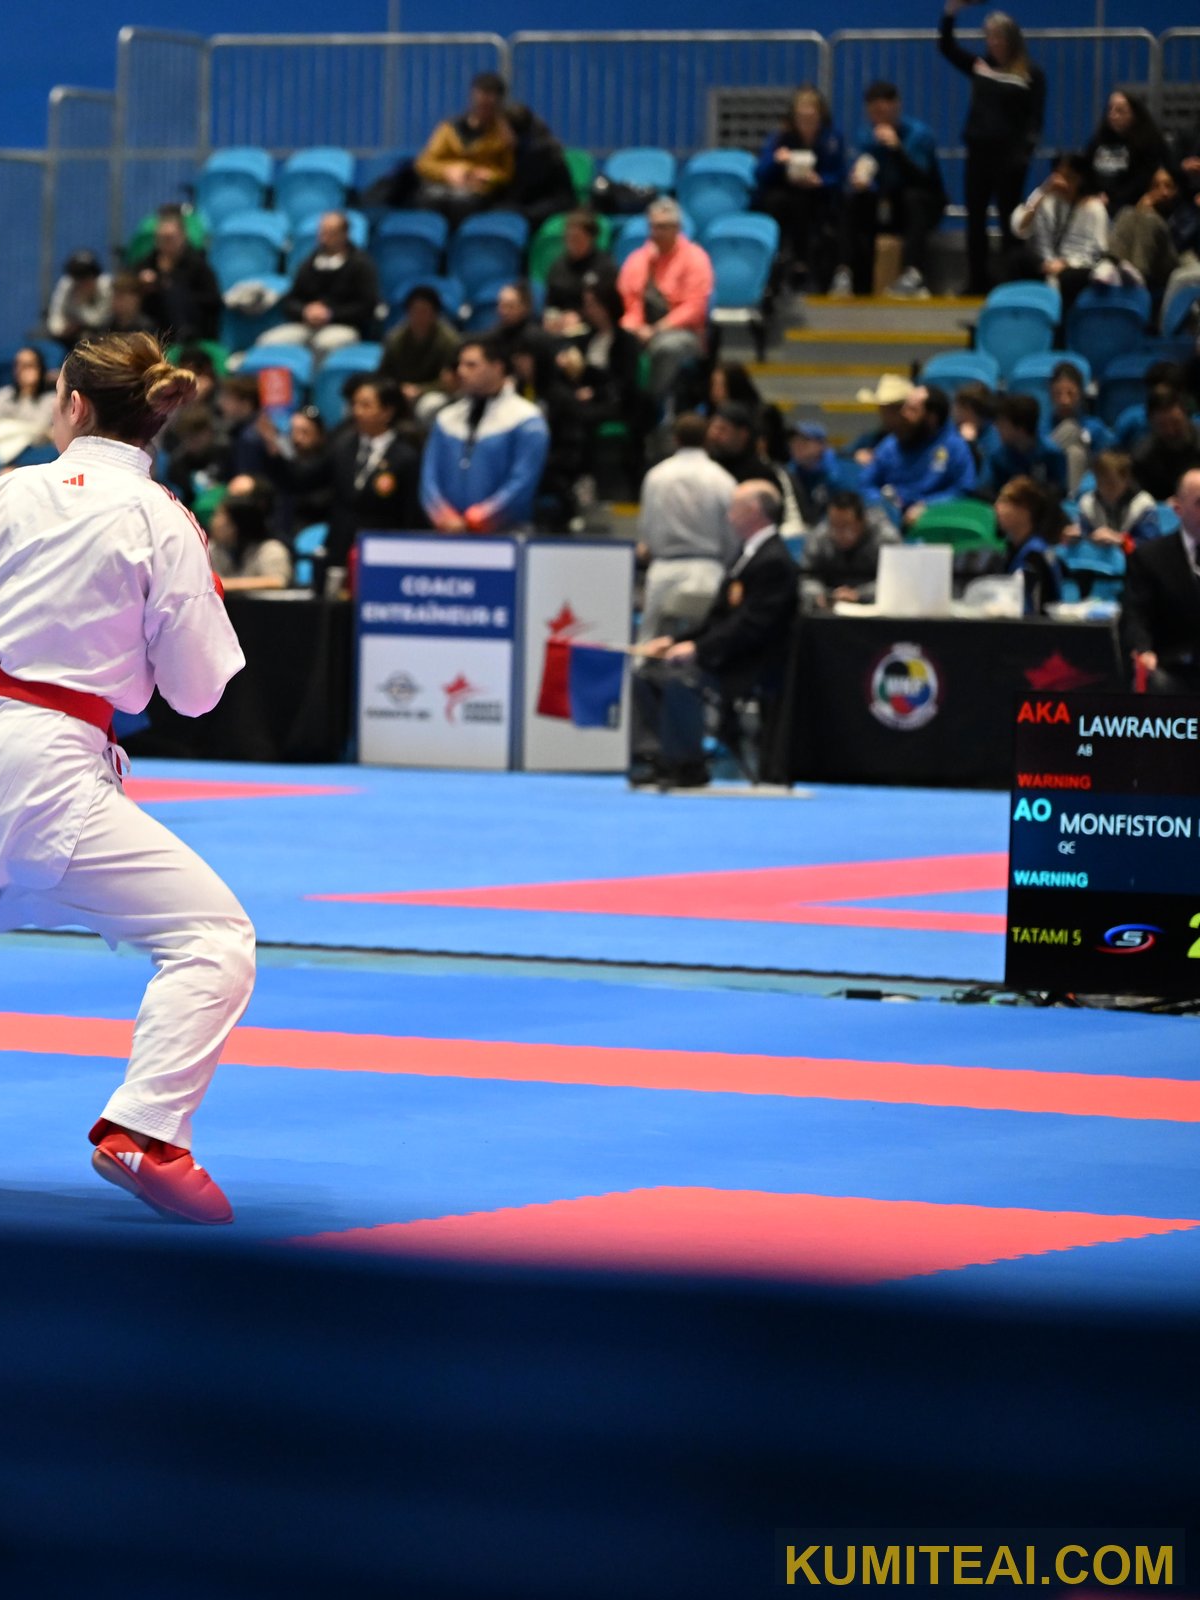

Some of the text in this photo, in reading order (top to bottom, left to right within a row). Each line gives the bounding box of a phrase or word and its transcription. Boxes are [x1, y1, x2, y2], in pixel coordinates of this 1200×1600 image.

[400, 575, 476, 598] COACH
[1017, 701, 1070, 723] AKA
[1078, 715, 1198, 739] LAWRANCE
[1076, 743, 1093, 757] AB
[1017, 773, 1092, 789] WARNING
[1013, 798, 1052, 822] AO
[1059, 812, 1191, 838] MONFISTON
[1057, 840, 1076, 855] QC
[1013, 870, 1088, 888] WARNING
[1011, 926, 1082, 946] TATAMI 5
